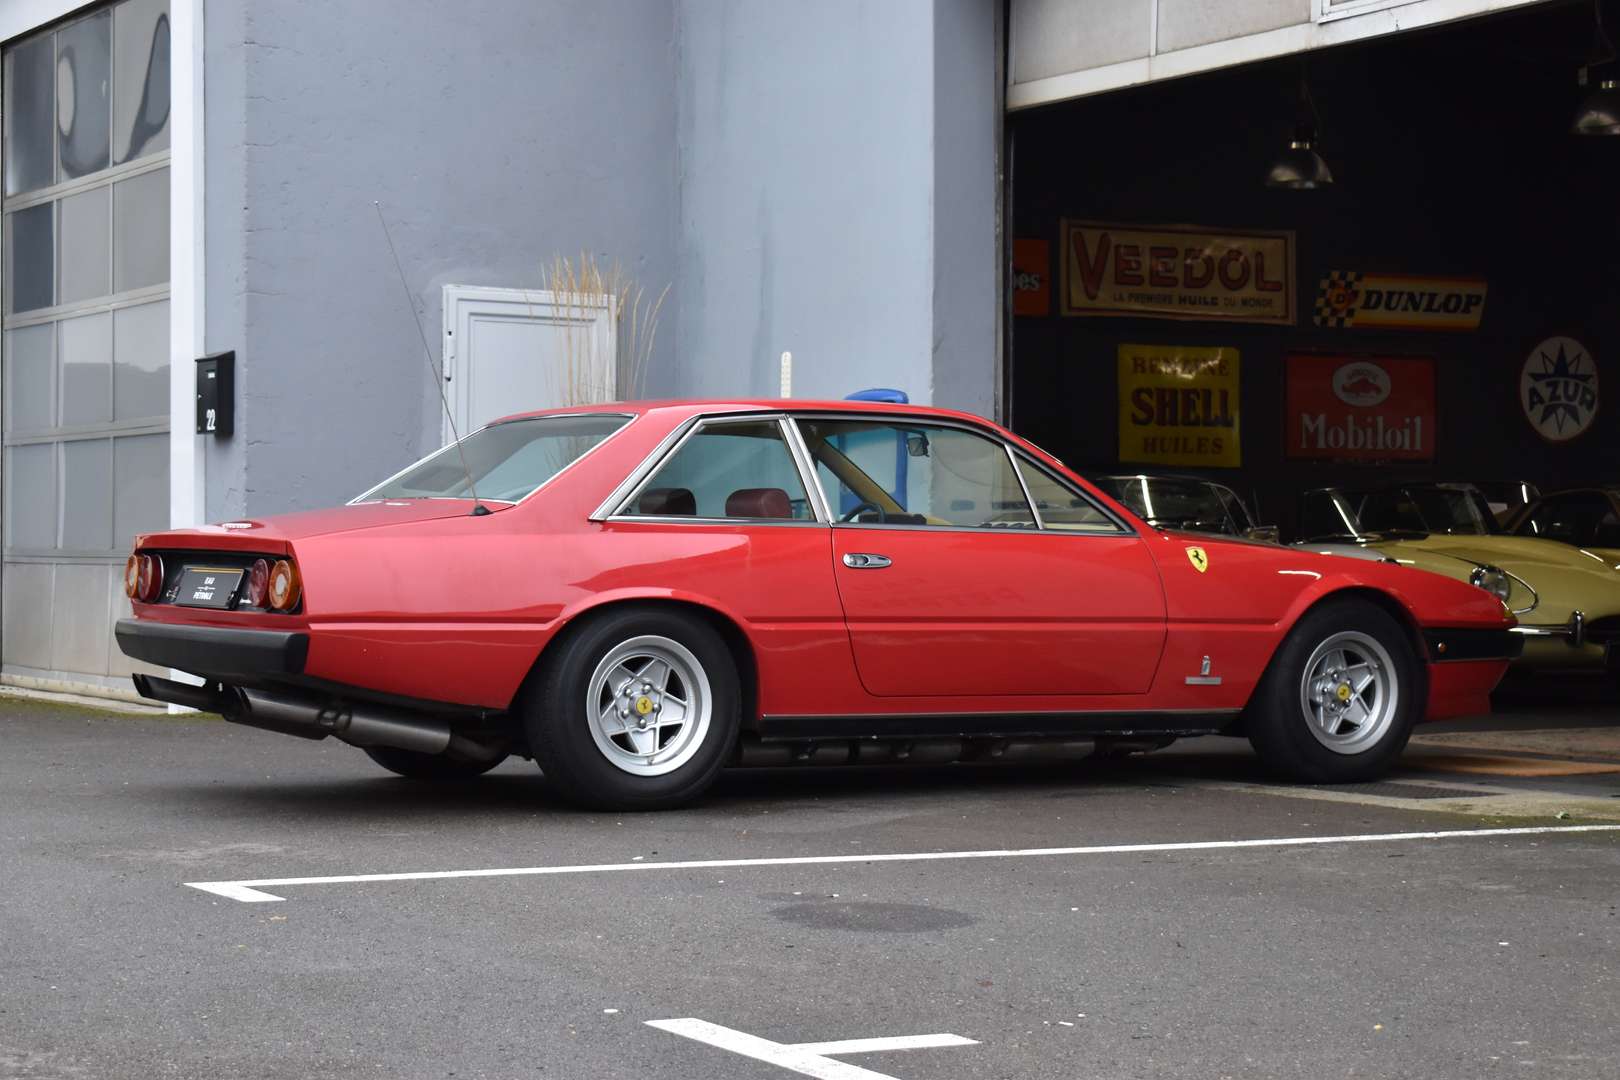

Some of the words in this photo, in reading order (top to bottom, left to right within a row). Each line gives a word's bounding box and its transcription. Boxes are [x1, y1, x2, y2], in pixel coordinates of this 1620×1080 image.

[1072, 231, 1282, 300] VEEDOL
[1178, 294, 1219, 306] HUILE
[1223, 296, 1235, 305] DU
[1360, 290, 1482, 314] DUNLOP
[1131, 387, 1234, 427] SHELL
[1528, 380, 1596, 412] AZUR
[206, 408, 216, 431] 22
[1300, 413, 1424, 451] Mobiloil
[1143, 437, 1225, 455] HUILES
